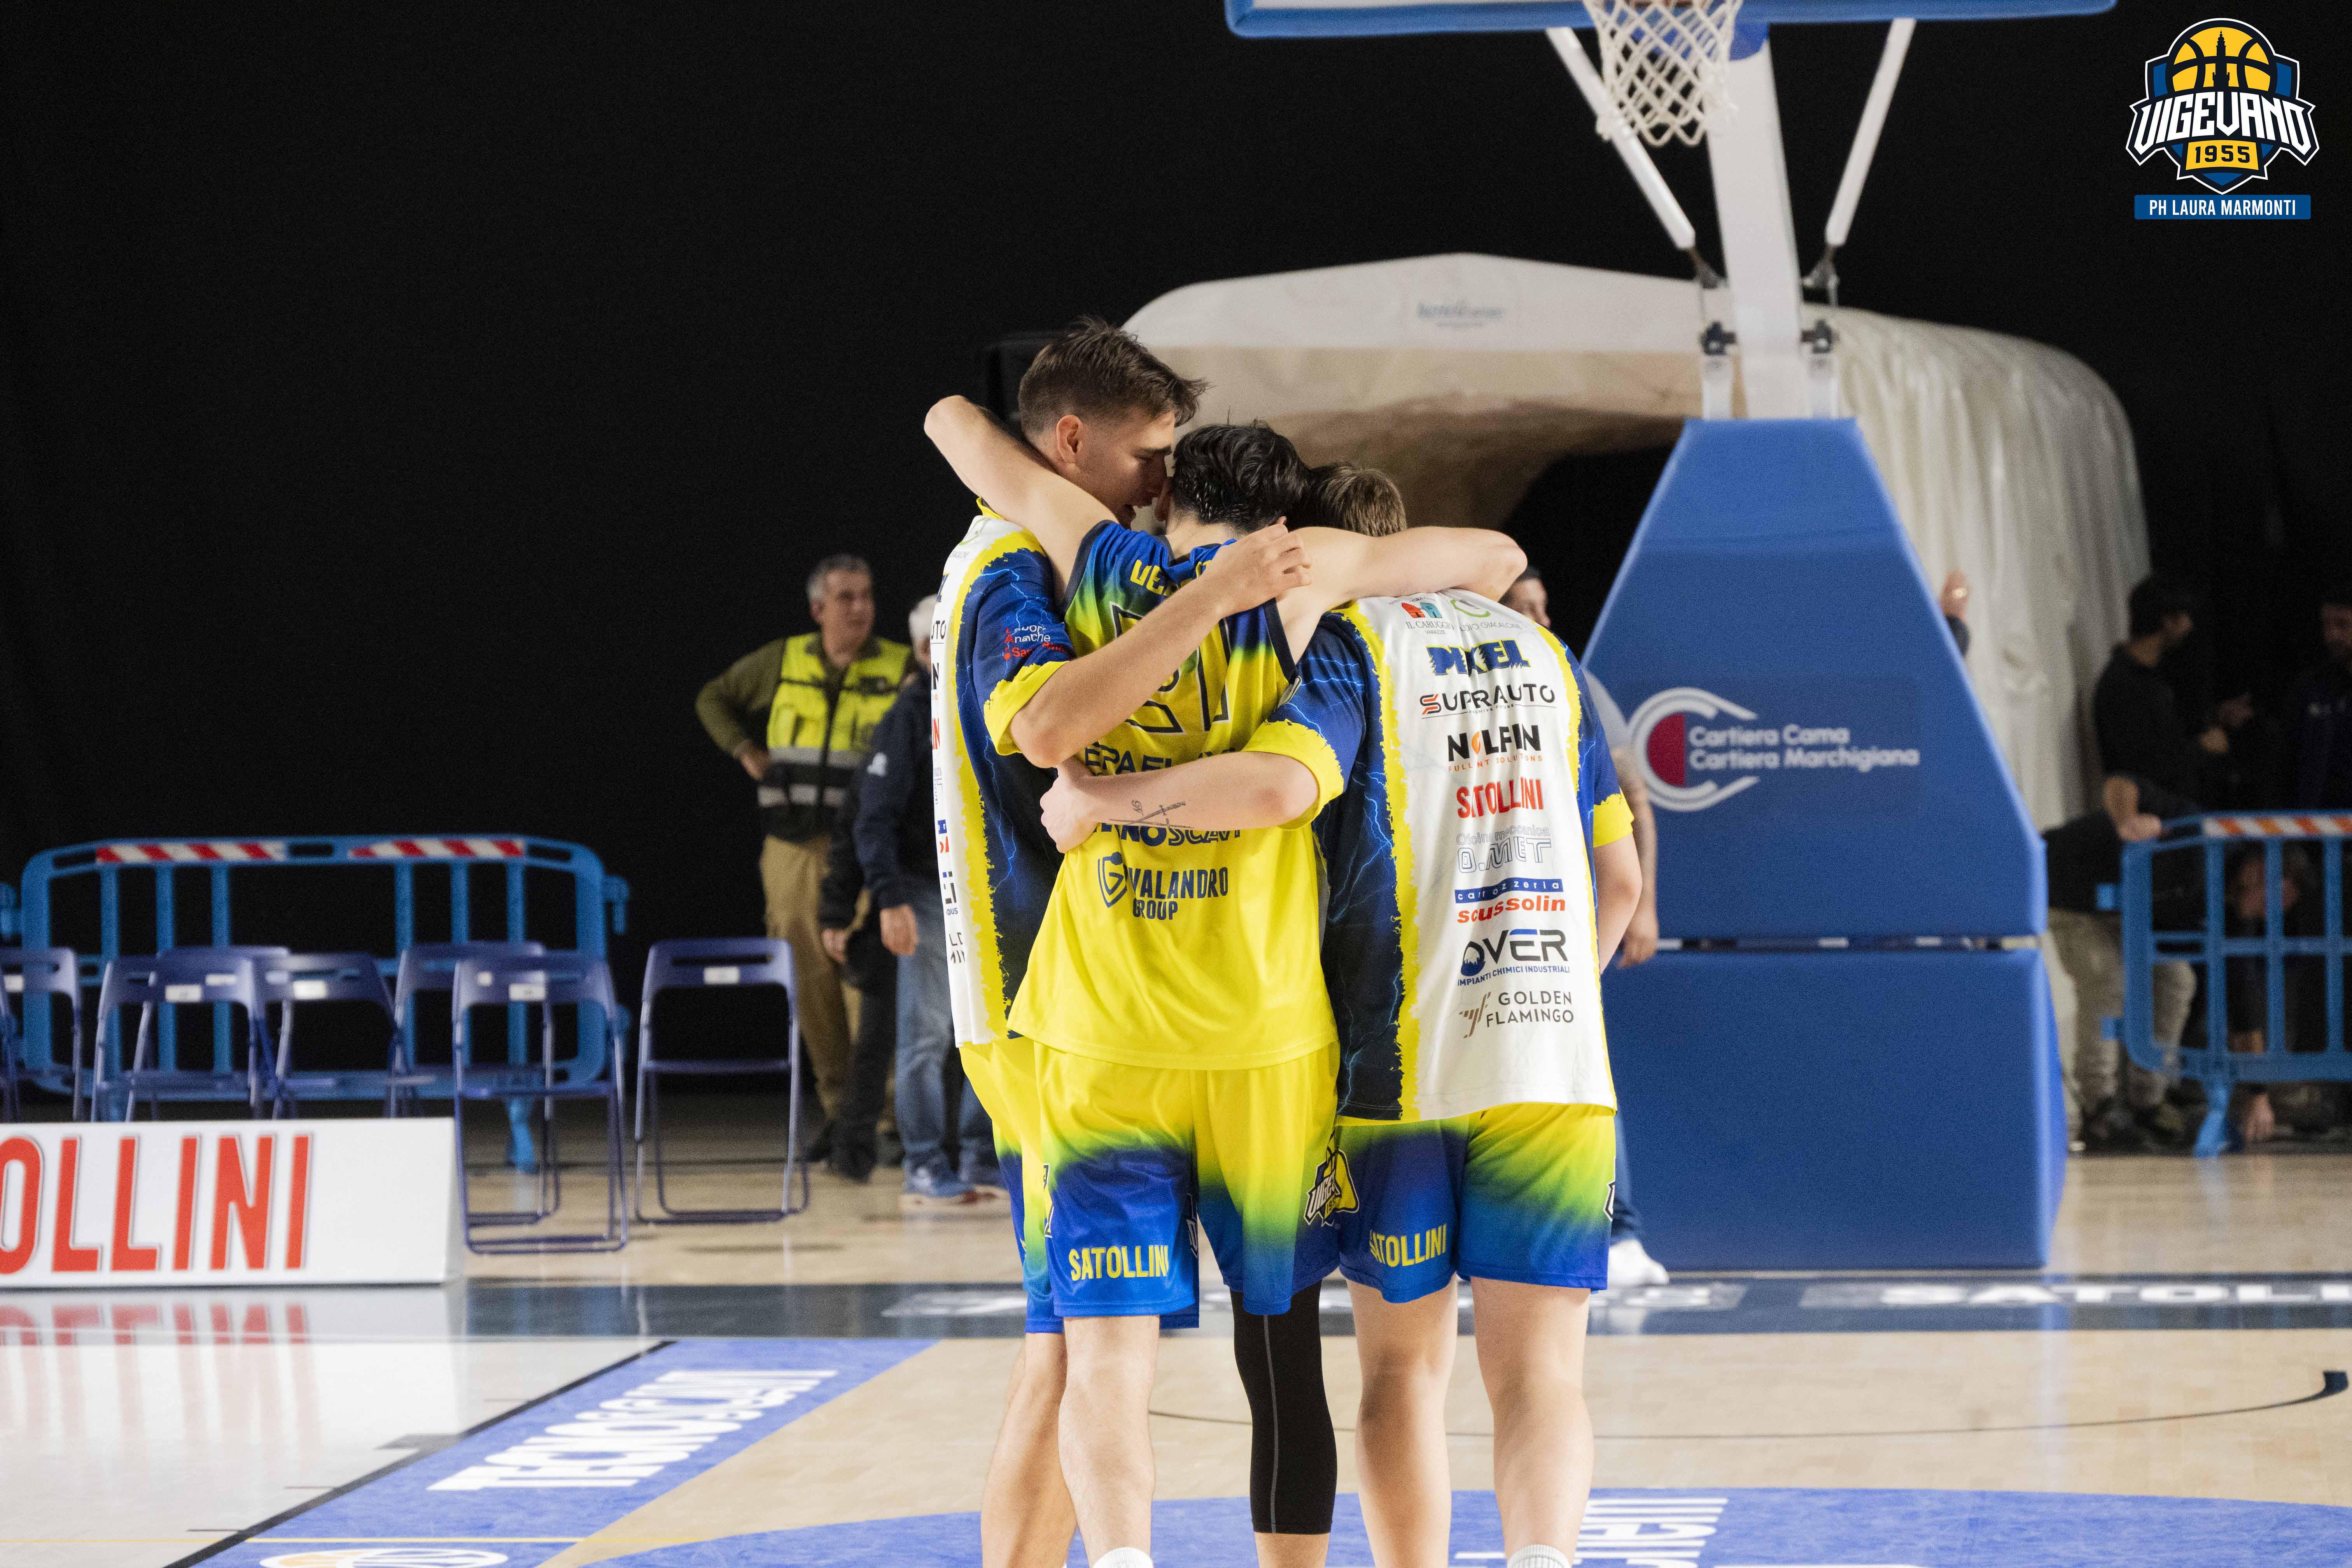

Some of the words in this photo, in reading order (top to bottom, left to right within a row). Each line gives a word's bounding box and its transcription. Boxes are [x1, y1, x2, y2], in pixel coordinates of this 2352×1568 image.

[1419, 683, 1556, 715] SUPRAUTO
[1128, 866, 1228, 900] VALANDRO
[1457, 895, 1566, 924] scussolin
[1461, 929, 1568, 977] OVER
[1458, 973, 1491, 986] IMPIANTI
[1492, 966, 1523, 977] CHIMICI
[1525, 965, 1570, 973] INDUSTRIALI
[1498, 991, 1572, 1006] GOLDEN
[1486, 1008, 1574, 1027] FLAMINGO
